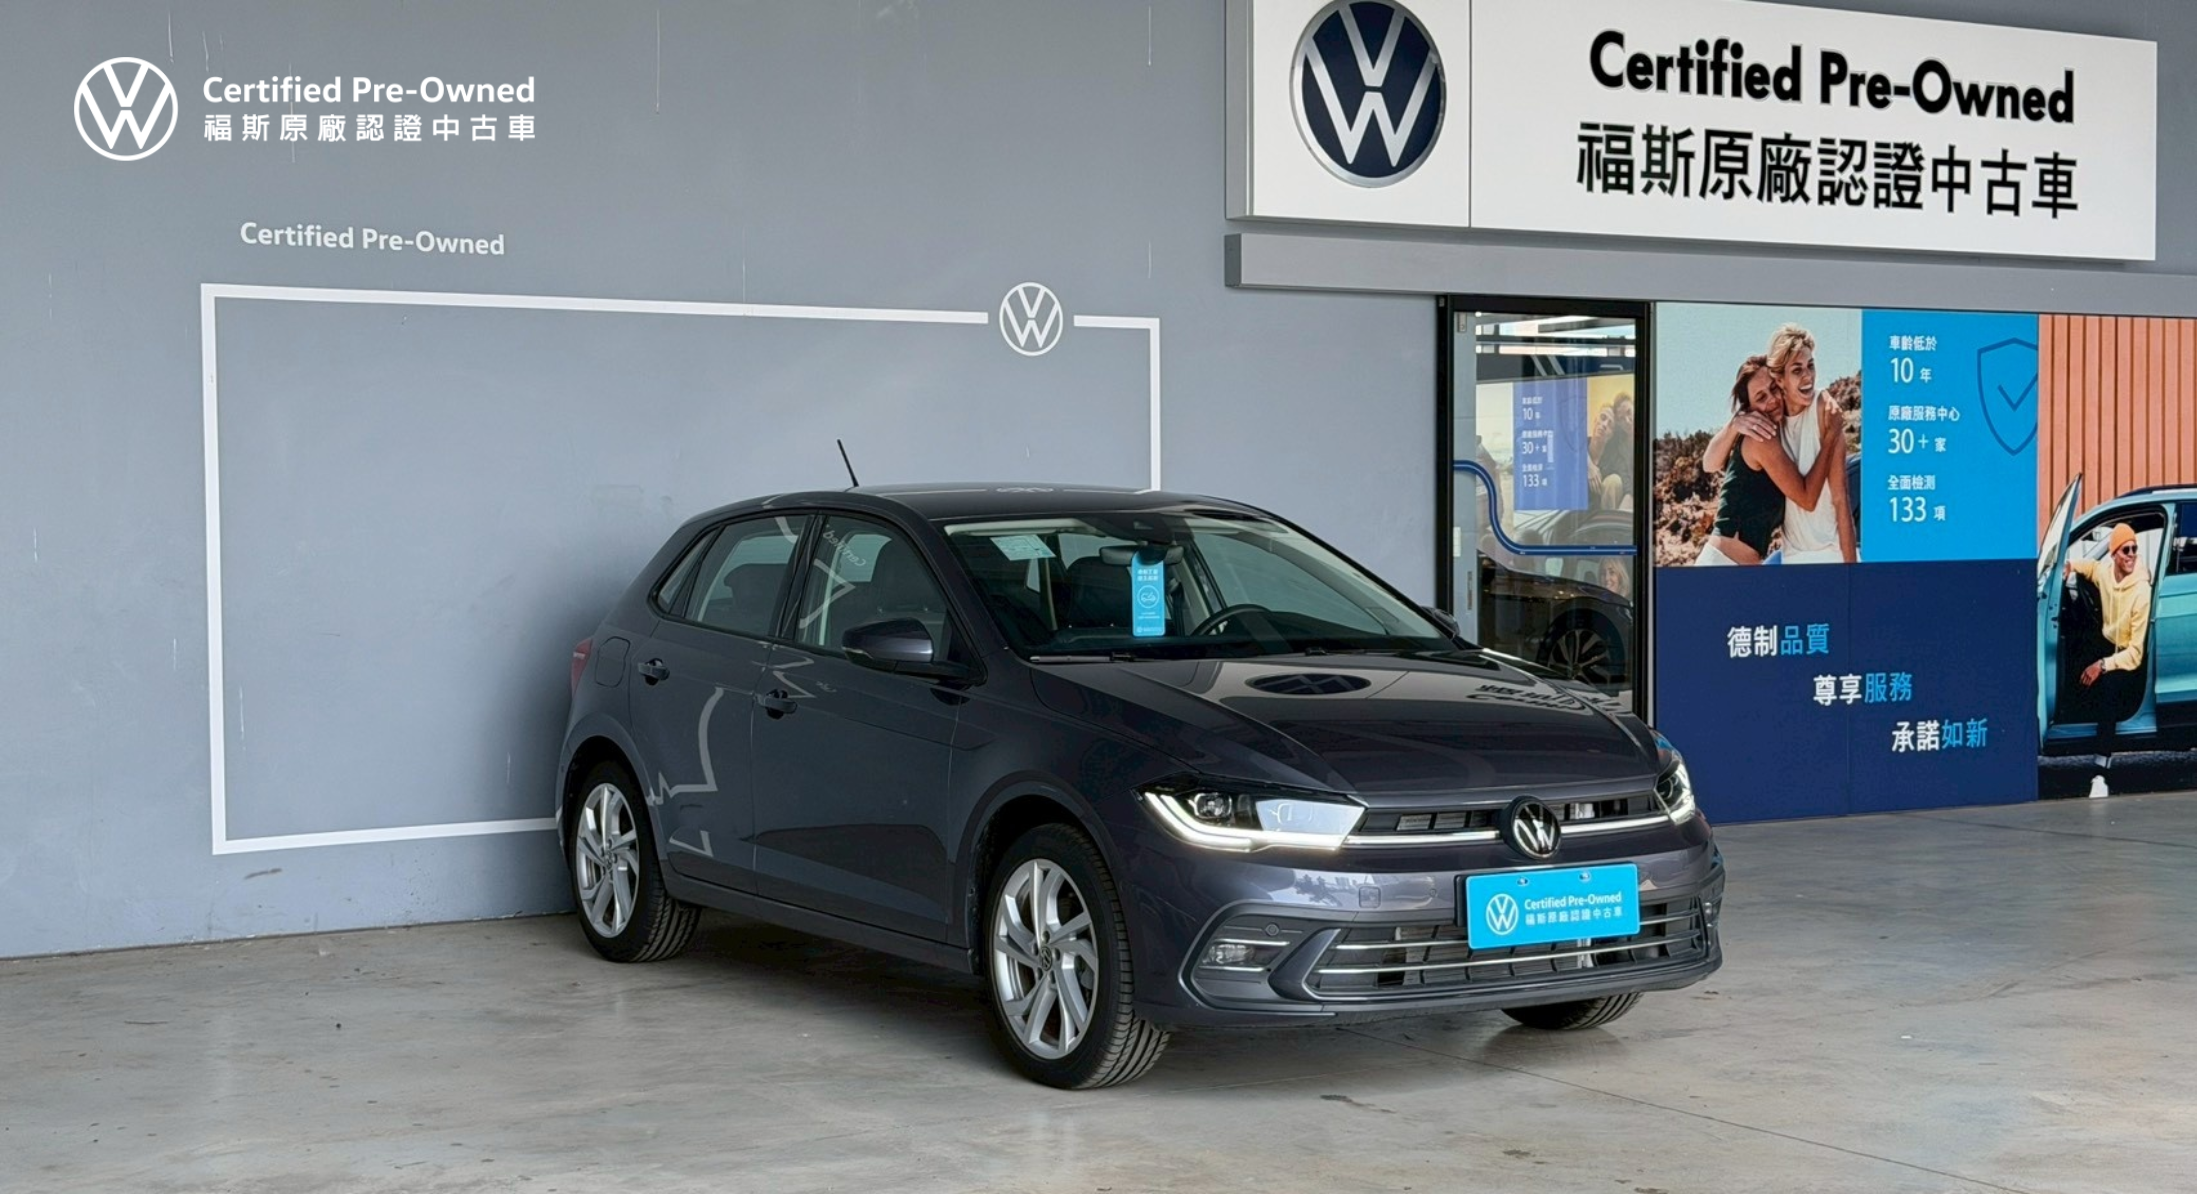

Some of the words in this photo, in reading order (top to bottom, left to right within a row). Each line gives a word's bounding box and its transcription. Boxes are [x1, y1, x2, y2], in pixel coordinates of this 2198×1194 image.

[1589, 30, 1803, 103] Certified
[1819, 49, 2075, 124] Pre-Owned
[1576, 121, 2079, 219] 福斯原廠認證中古車
[240, 222, 354, 248] Certified
[362, 228, 505, 255] Pre-Owned
[1889, 335, 1937, 351] 車齡低於
[1890, 357, 1914, 383] 10
[1920, 367, 1932, 383] 年
[1888, 405, 1960, 421] 原廠服務中心
[1887, 474, 1936, 490] 全面檢測
[1889, 496, 1927, 522] 133
[1933, 505, 1946, 521] 項
[1727, 623, 1830, 658] 德制品質
[1813, 671, 1912, 706] 尊享服務
[1892, 718, 1988, 752] 承諾如新
[1524, 896, 1567, 910] Certified
[1568, 891, 1622, 907] Pre-Owned
